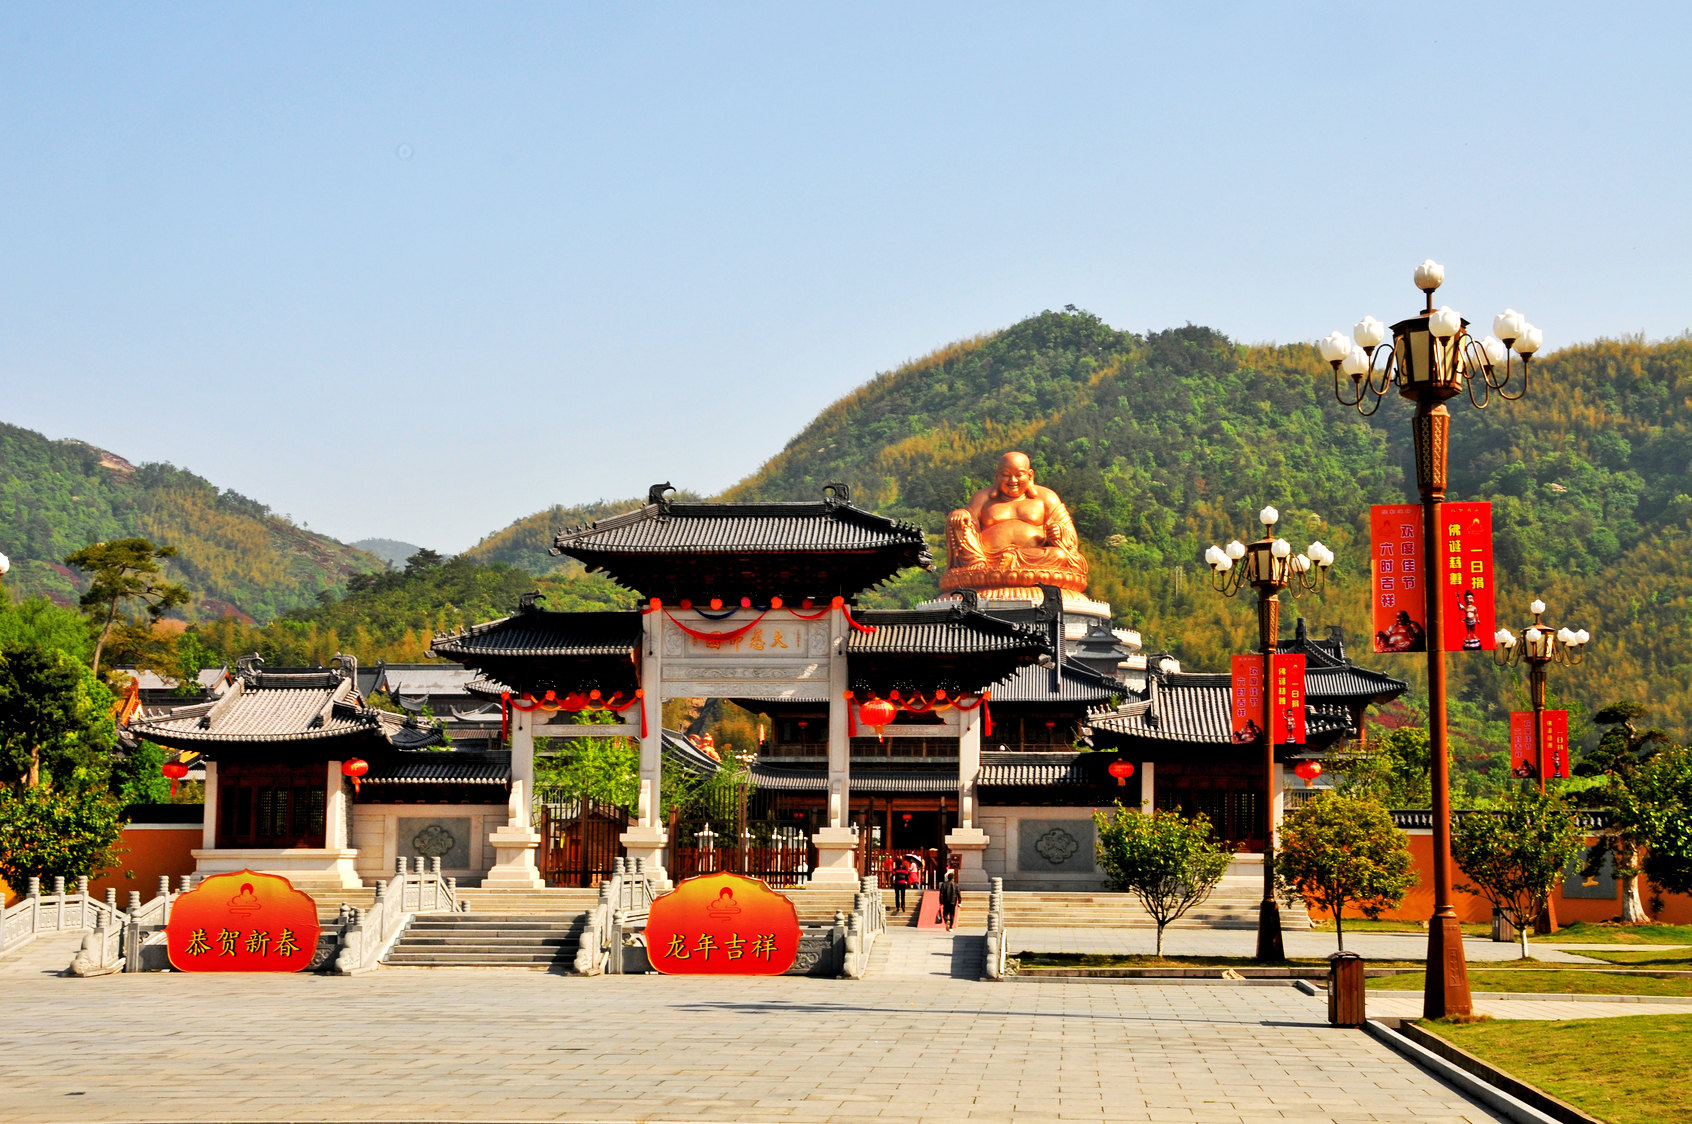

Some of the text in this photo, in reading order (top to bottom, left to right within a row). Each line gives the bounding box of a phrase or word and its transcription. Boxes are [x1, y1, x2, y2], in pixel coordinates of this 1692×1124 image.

[1380, 542, 1395, 607] 六时吉祥
[1401, 524, 1416, 589] 欢度佳节
[1448, 523, 1462, 585] 佛诞慈善
[1470, 549, 1484, 589] 一日捐
[185, 928, 302, 957] 恭贺新春
[664, 932, 779, 962] 龙年吉祥
